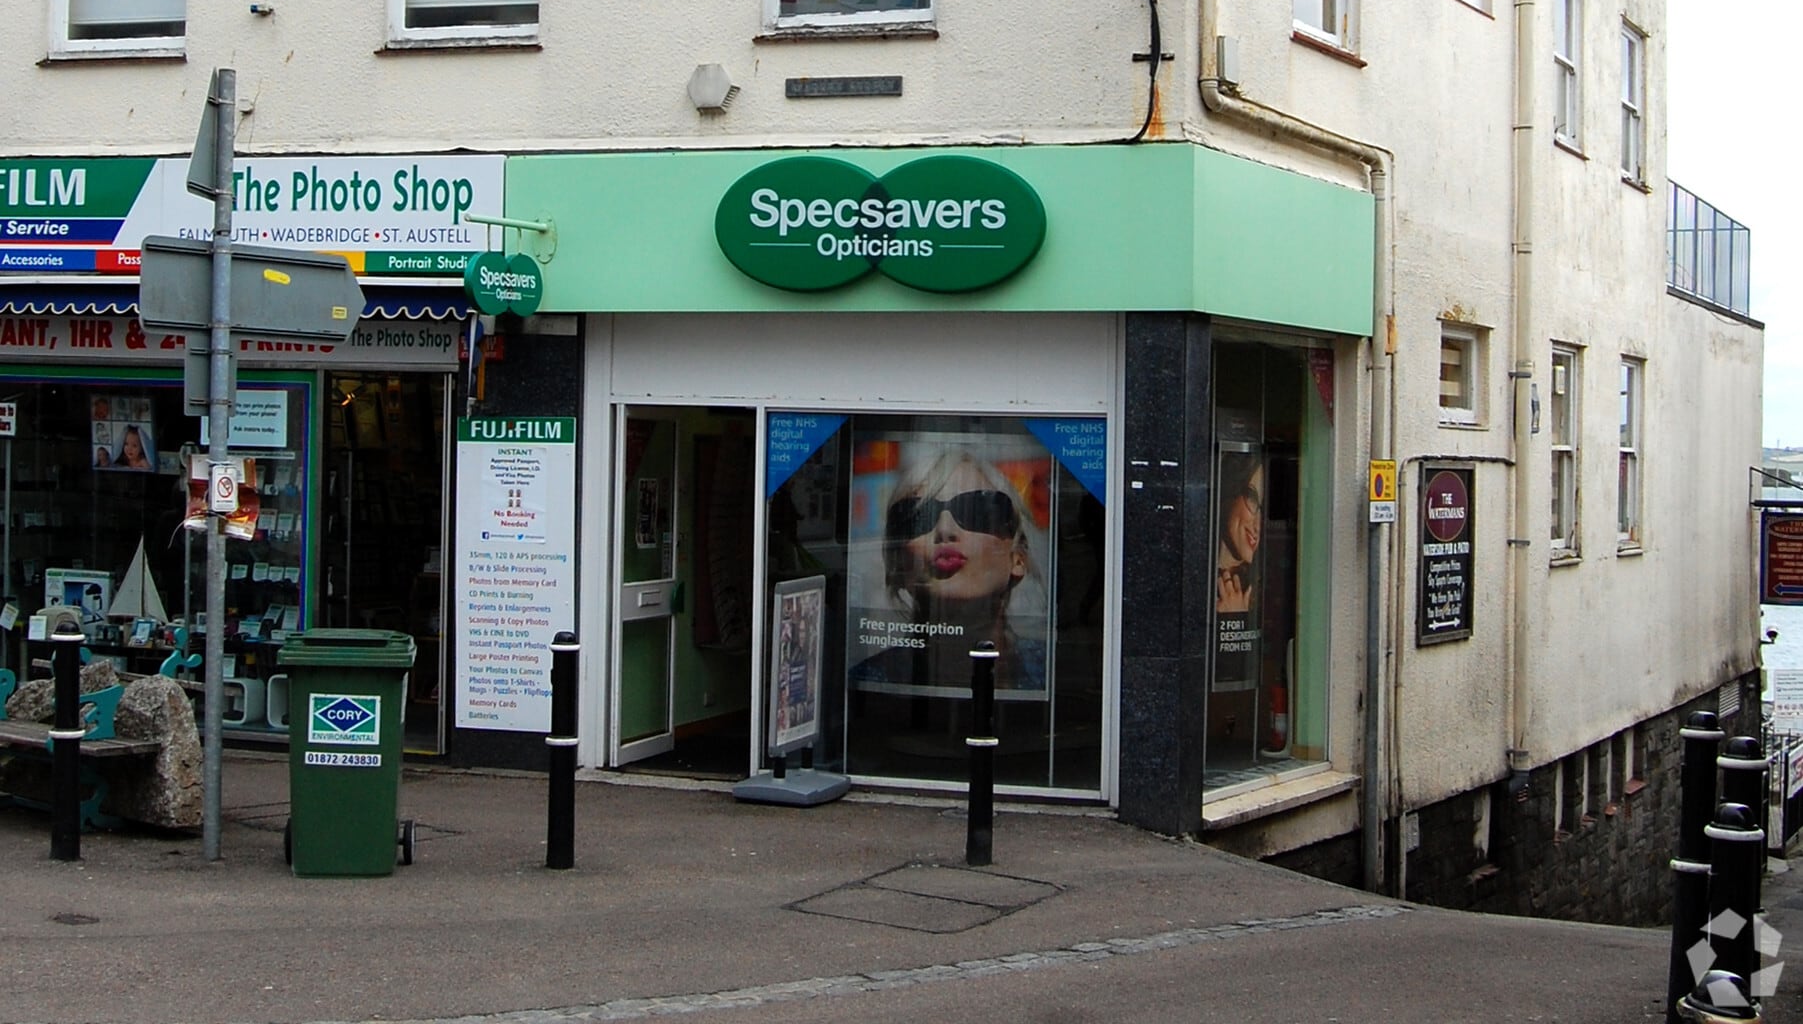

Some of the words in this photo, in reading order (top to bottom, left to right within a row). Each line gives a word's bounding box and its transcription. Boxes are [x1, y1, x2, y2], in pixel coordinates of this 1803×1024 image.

[232, 166, 281, 212] The
[291, 165, 381, 212] Photo
[393, 164, 473, 224] Shop
[750, 188, 1006, 236] Specsavers
[7, 220, 70, 236] Service
[179, 228, 259, 242] FALMUTH
[271, 228, 369, 243] WADEBRIDGE
[382, 228, 402, 243] ST.
[406, 228, 471, 243] AUSTELL
[816, 233, 933, 260] Opticians
[2, 253, 63, 266] Accessories
[118, 252, 141, 265] Pass
[388, 255, 432, 269] Portrait
[437, 256, 468, 269] Studi
[480, 265, 536, 290] Specsavers
[495, 287, 522, 301] Opticians
[0, 319, 56, 350] ANT,
[125, 319, 147, 350] &
[351, 329, 372, 346] The
[376, 329, 414, 347] Photo
[418, 328, 452, 352] Shop
[771, 416, 793, 427] Free
[795, 417, 818, 428] NHS
[1055, 423, 1077, 433] Free
[1080, 423, 1104, 433] NHS
[771, 428, 803, 441] digital
[1069, 434, 1104, 447] digital
[498, 448, 533, 456] INSTANT
[771, 440, 810, 453] hearing
[770, 452, 791, 463] aids
[1062, 446, 1104, 460] hearing
[1081, 459, 1104, 469] aids
[1441, 492, 1453, 505] THE
[506, 510, 535, 519] Booking
[500, 520, 528, 528] Needed
[495, 551, 508, 559] 120
[530, 553, 567, 563] processing
[493, 564, 509, 572] Slide
[511, 565, 547, 575] Processing
[493, 578, 511, 586] from
[511, 578, 539, 588] Memory
[541, 579, 557, 587] Card
[469, 590, 478, 598] CD
[479, 590, 499, 598] Prints
[469, 603, 496, 612] Reprints
[504, 603, 551, 613] Enlargements
[469, 617, 499, 626] Scanning
[507, 617, 524, 627] Copy
[525, 618, 549, 626] Photos
[859, 618, 885, 630] Free
[888, 621, 964, 637] prescription
[1220, 620, 1225, 630] 2
[1226, 620, 1241, 630] FOR
[469, 628, 482, 636] VHS
[515, 630, 530, 638] DVD
[494, 641, 522, 650] Passport
[524, 642, 547, 650] Photos
[859, 634, 926, 649] sunglasses
[1219, 641, 1240, 652] FROM
[469, 653, 487, 662] Large
[488, 653, 510, 662] Poster
[511, 654, 539, 664] Printing
[485, 666, 508, 674] Photos
[510, 667, 517, 675] to
[519, 667, 543, 676] Canvas
[469, 676, 491, 684] Photos
[469, 686, 487, 695] Mugs
[493, 687, 518, 695] Puzzles
[469, 699, 497, 709] Memory
[498, 700, 517, 708] Cards
[327, 709, 363, 721] CORY
[469, 711, 499, 720] Batteries
[312, 732, 375, 742] ENVIRONMENTAL
[307, 753, 338, 764] 01872
[342, 754, 379, 765] 243830
